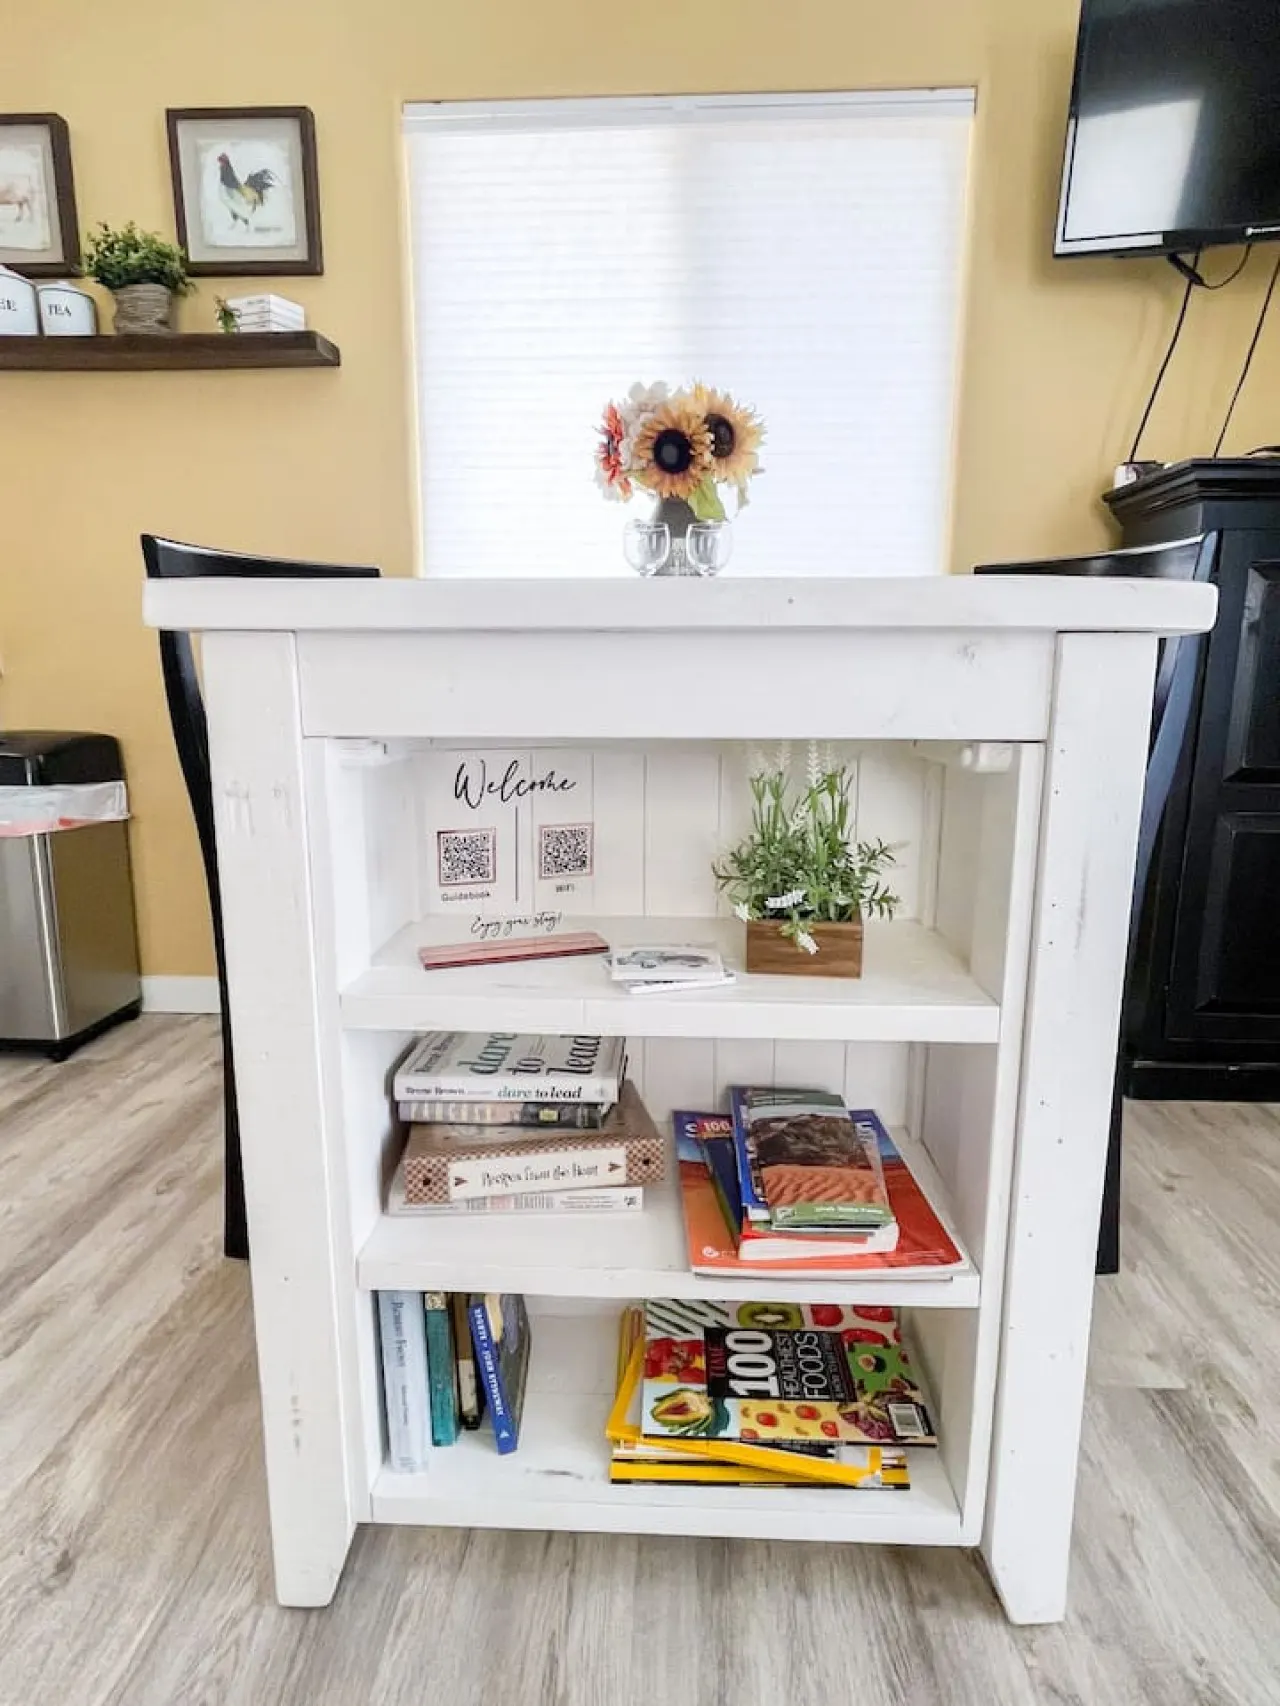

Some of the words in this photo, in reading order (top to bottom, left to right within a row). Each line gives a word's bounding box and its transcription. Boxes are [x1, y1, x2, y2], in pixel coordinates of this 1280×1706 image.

[48, 303, 72, 316] TEA
[454, 758, 577, 810] Welcome
[441, 890, 491, 902] Guidebook
[470, 915, 501, 939] Enjoy
[503, 918, 529, 936] your
[533, 911, 562, 932] stay!
[457, 1032, 518, 1075] dare
[506, 1057, 545, 1076] to
[546, 1034, 602, 1076] lead
[497, 1084, 533, 1100] dare
[534, 1088, 548, 1100] to
[549, 1085, 582, 1100] lead
[724, 1329, 781, 1398] 100
[775, 1331, 800, 1399] HEALTHIEST
[794, 1331, 831, 1400] FOODS
